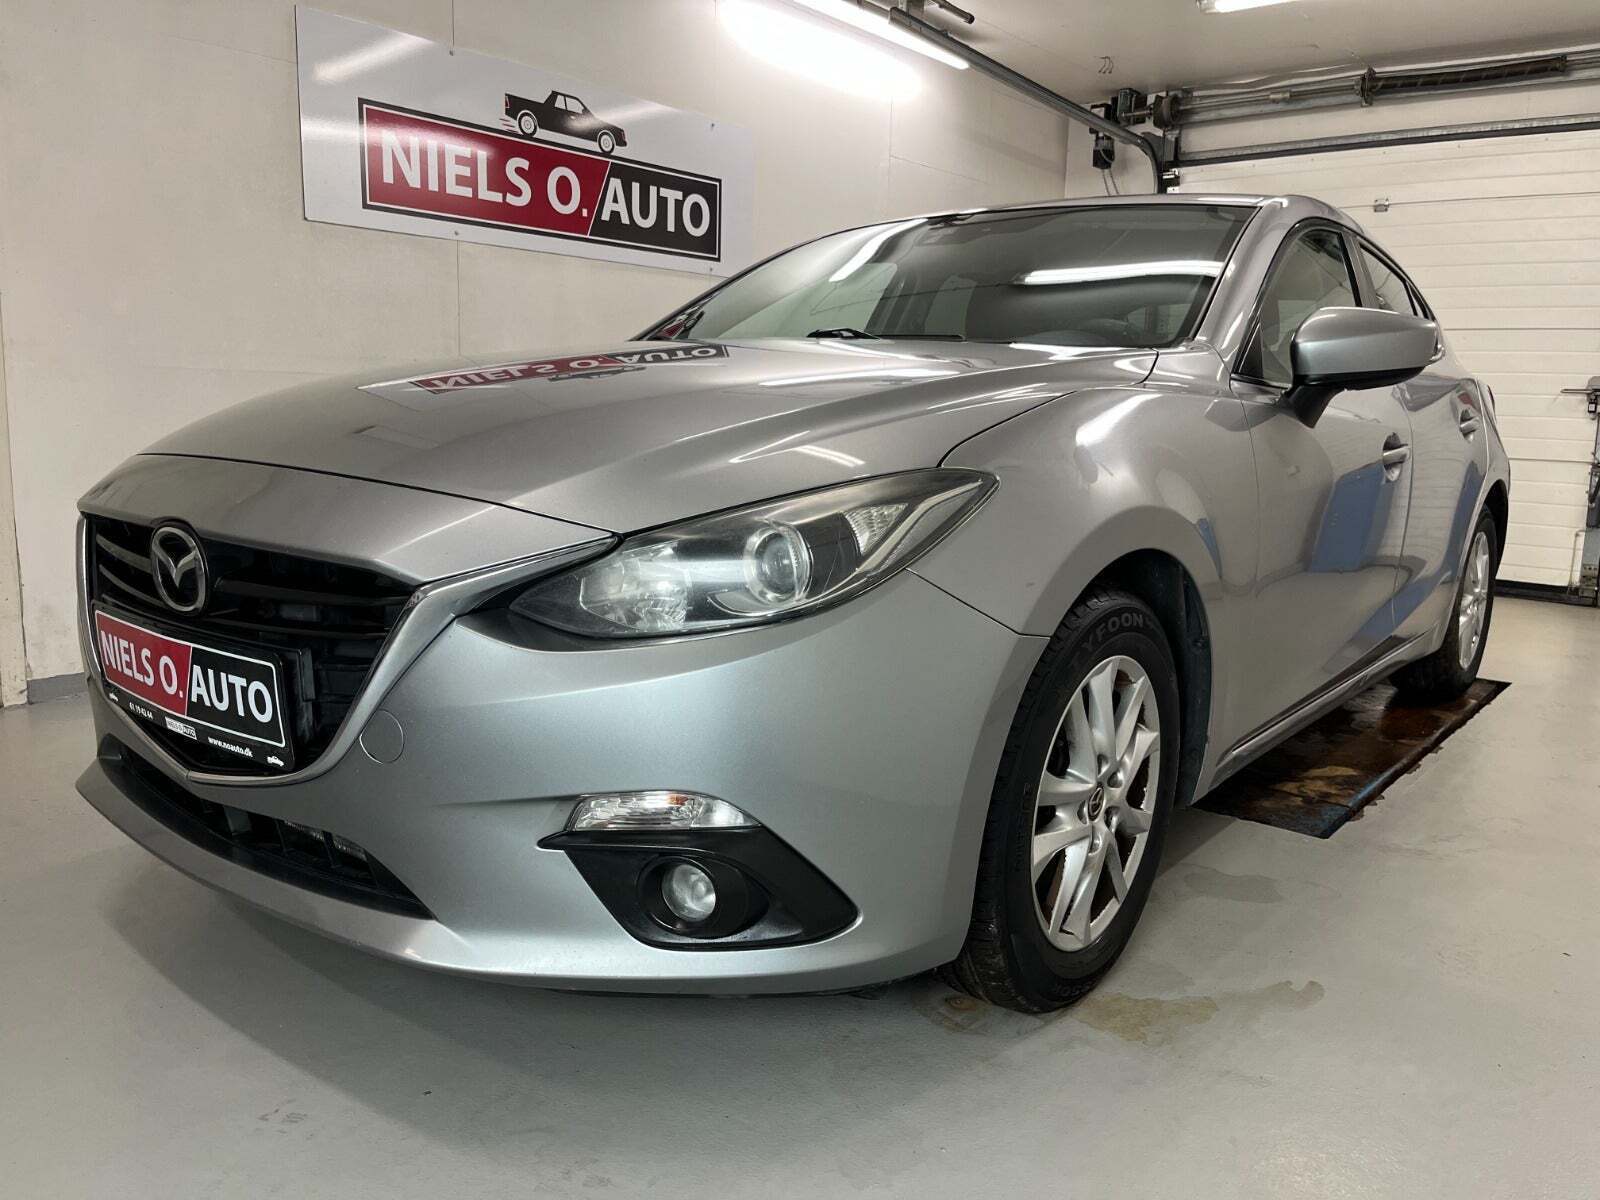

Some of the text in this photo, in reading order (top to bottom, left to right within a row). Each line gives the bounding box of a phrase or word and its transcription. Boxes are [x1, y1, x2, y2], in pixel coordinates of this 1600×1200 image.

[381, 131, 711, 238] NIELS O. AUTO
[100, 631, 273, 723] NIELS O. AUTO
[207, 736, 253, 757] www.noauto.dk
